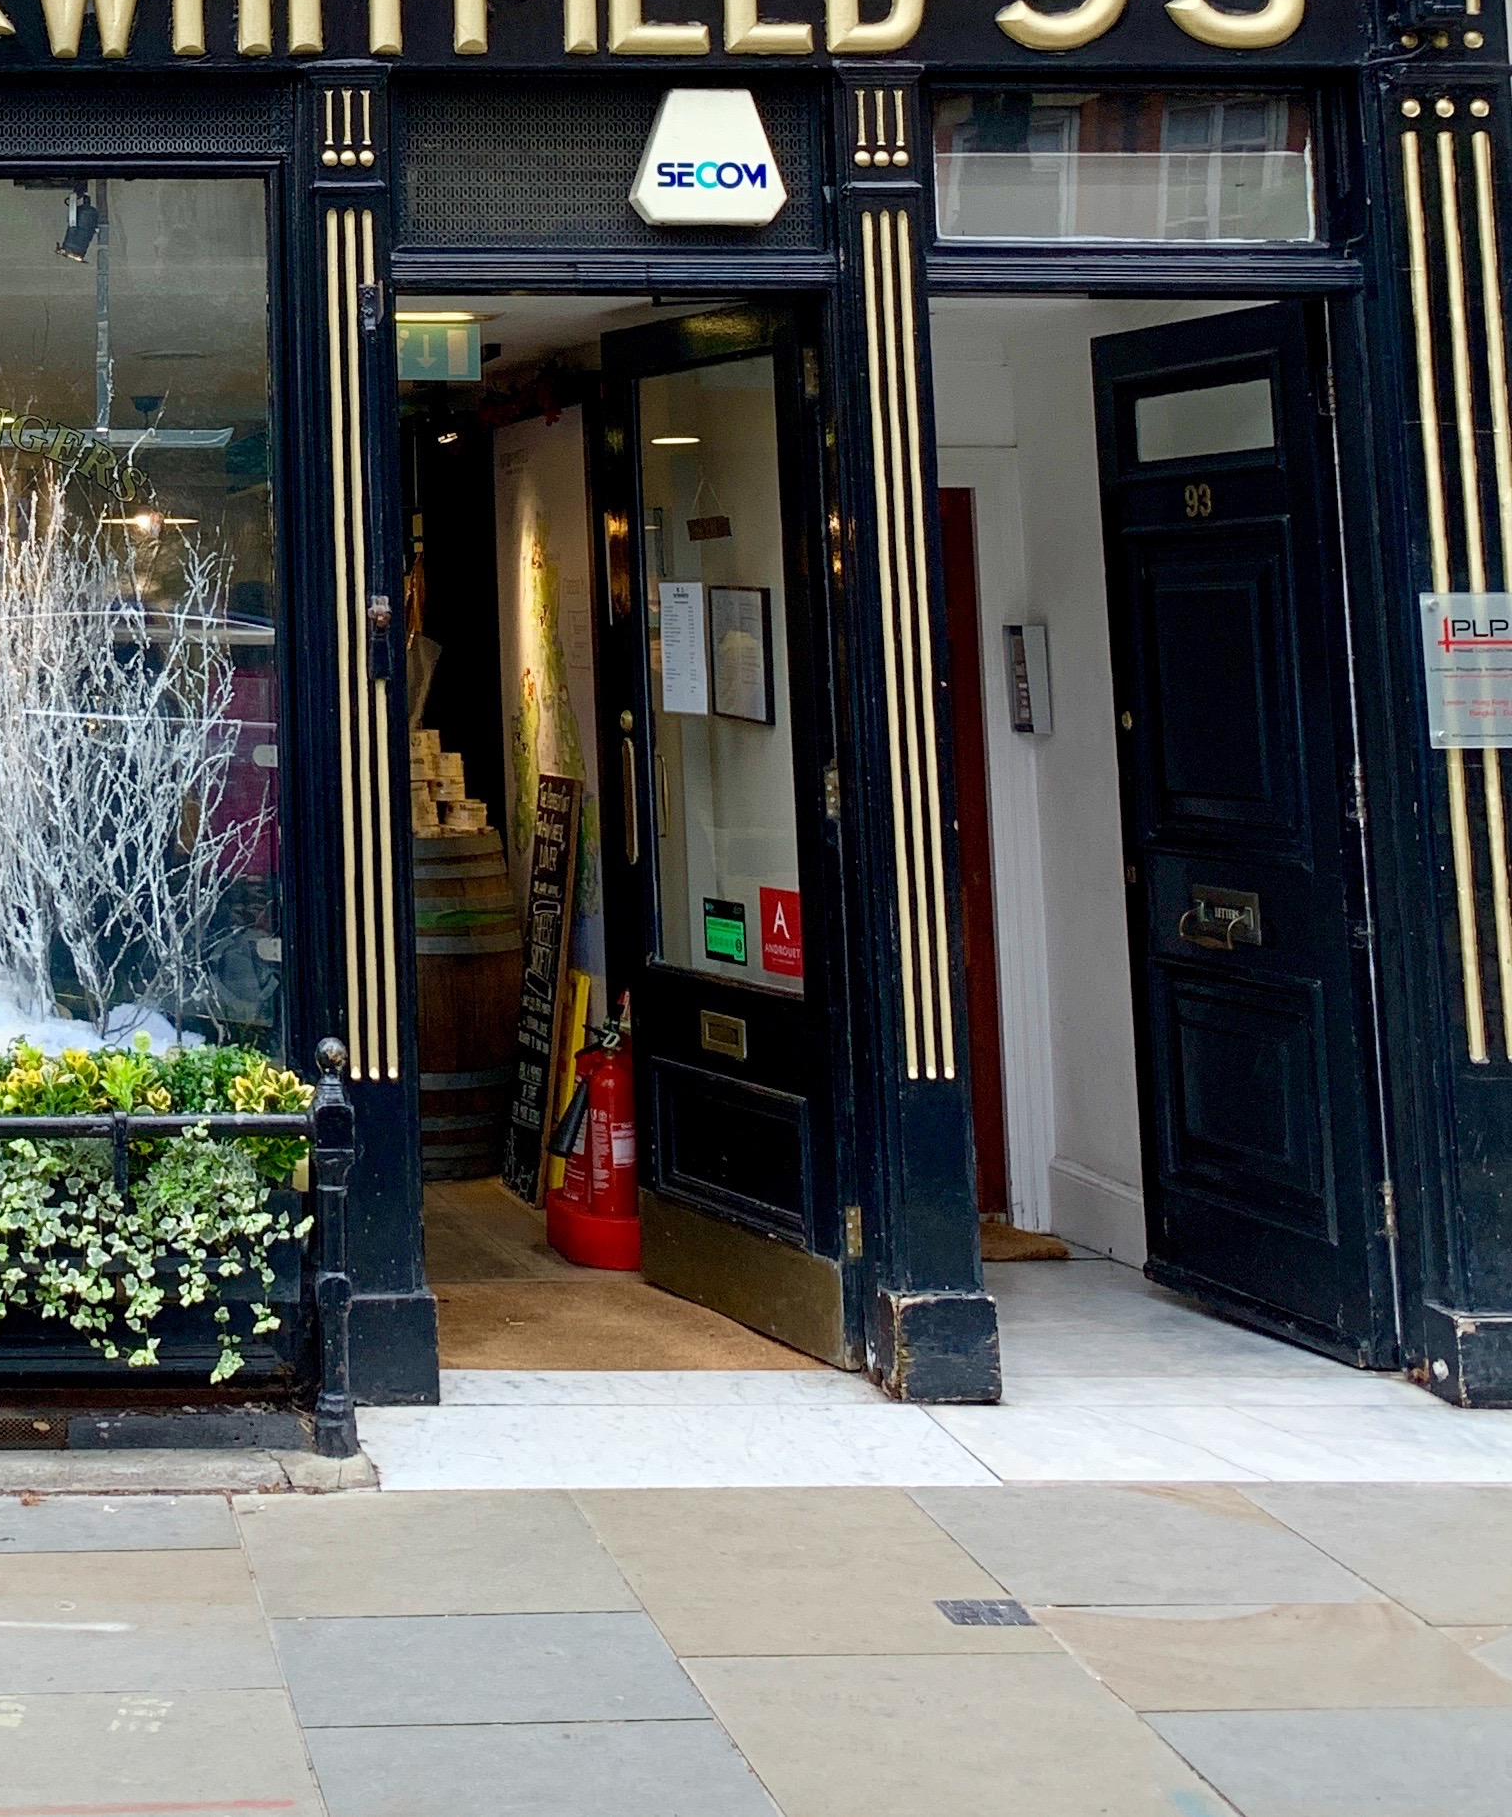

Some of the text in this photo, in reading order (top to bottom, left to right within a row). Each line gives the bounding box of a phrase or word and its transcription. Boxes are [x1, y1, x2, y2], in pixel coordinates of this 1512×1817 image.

[657, 161, 766, 189] SECOM
[1185, 484, 1211, 517] 93
[1451, 619, 1509, 638] PLP
[773, 901, 790, 940] A
